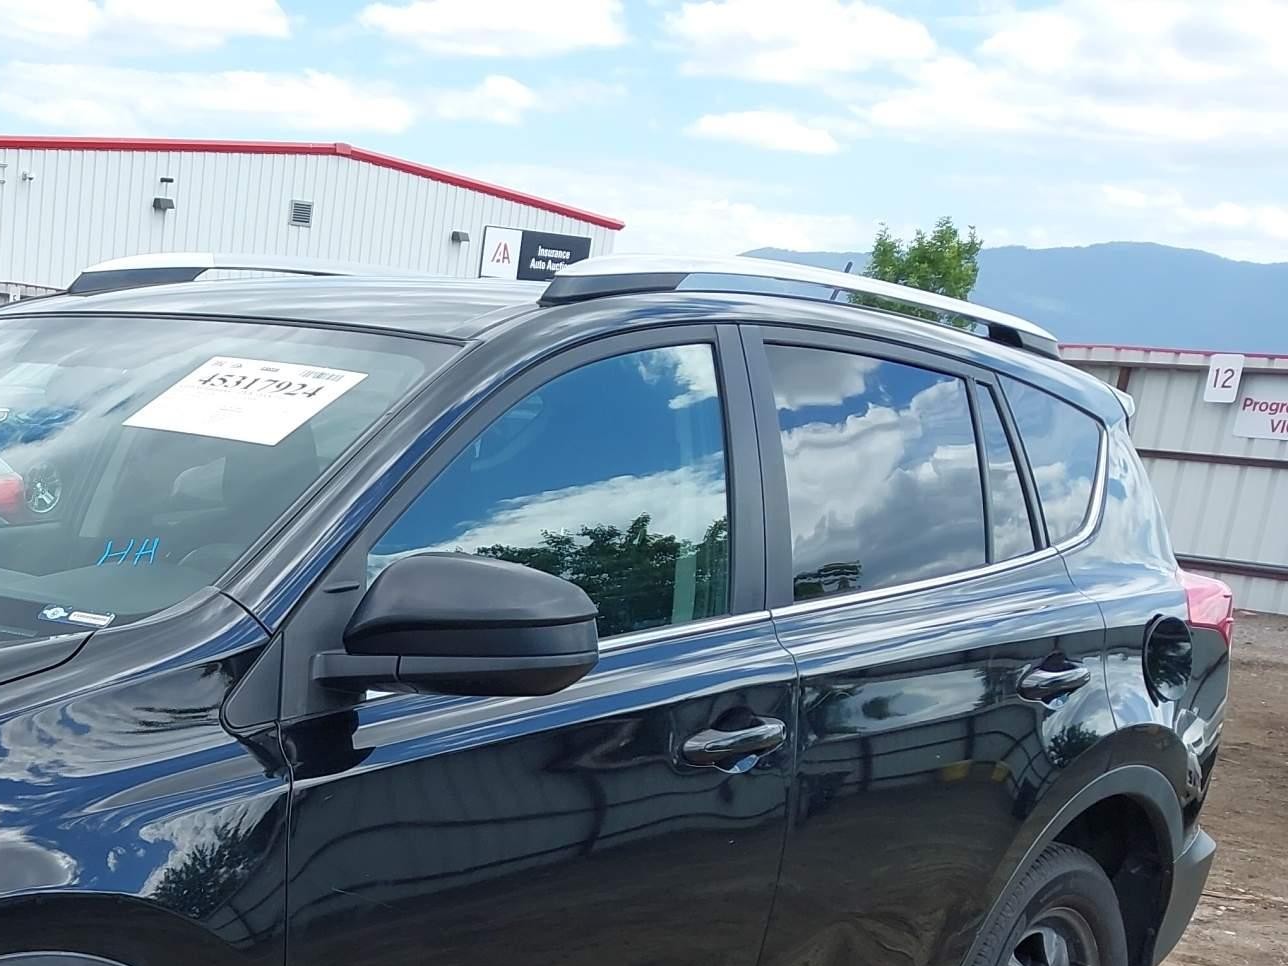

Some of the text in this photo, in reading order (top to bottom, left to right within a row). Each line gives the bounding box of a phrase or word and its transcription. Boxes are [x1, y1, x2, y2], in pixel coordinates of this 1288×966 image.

[537, 245, 571, 260] Insurance
[529, 258, 546, 271] Auto
[198, 372, 325, 398] 45317924
[1213, 368, 1235, 389] 12
[1270, 418, 1288, 434] VI
